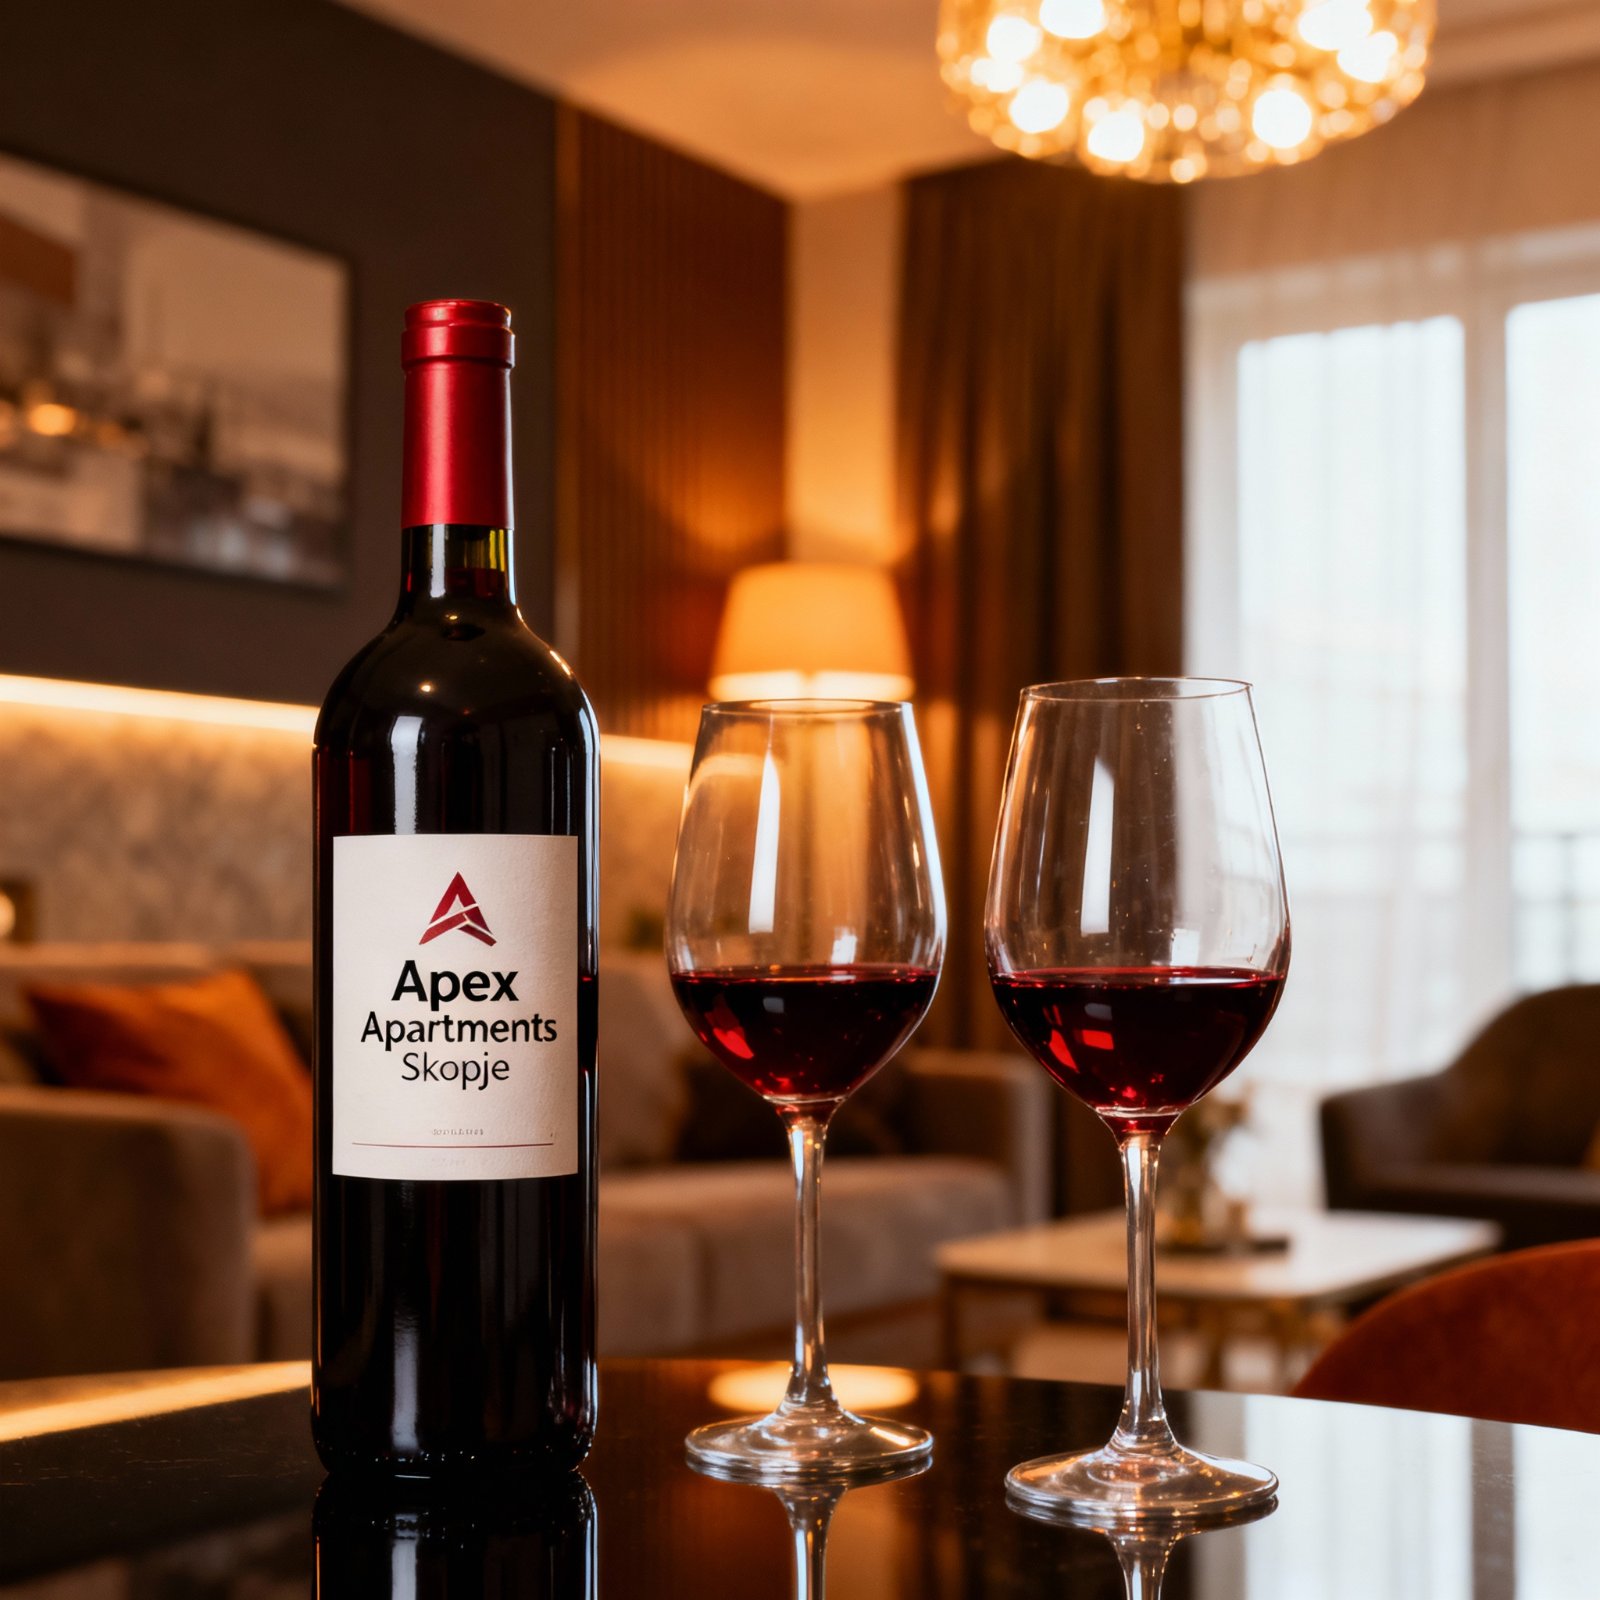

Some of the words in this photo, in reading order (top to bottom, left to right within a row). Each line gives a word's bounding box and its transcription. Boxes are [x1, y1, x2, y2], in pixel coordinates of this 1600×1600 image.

[391, 960, 519, 1011] Apex
[361, 1011, 557, 1051] Apartments
[401, 1052, 510, 1090] Skopje
